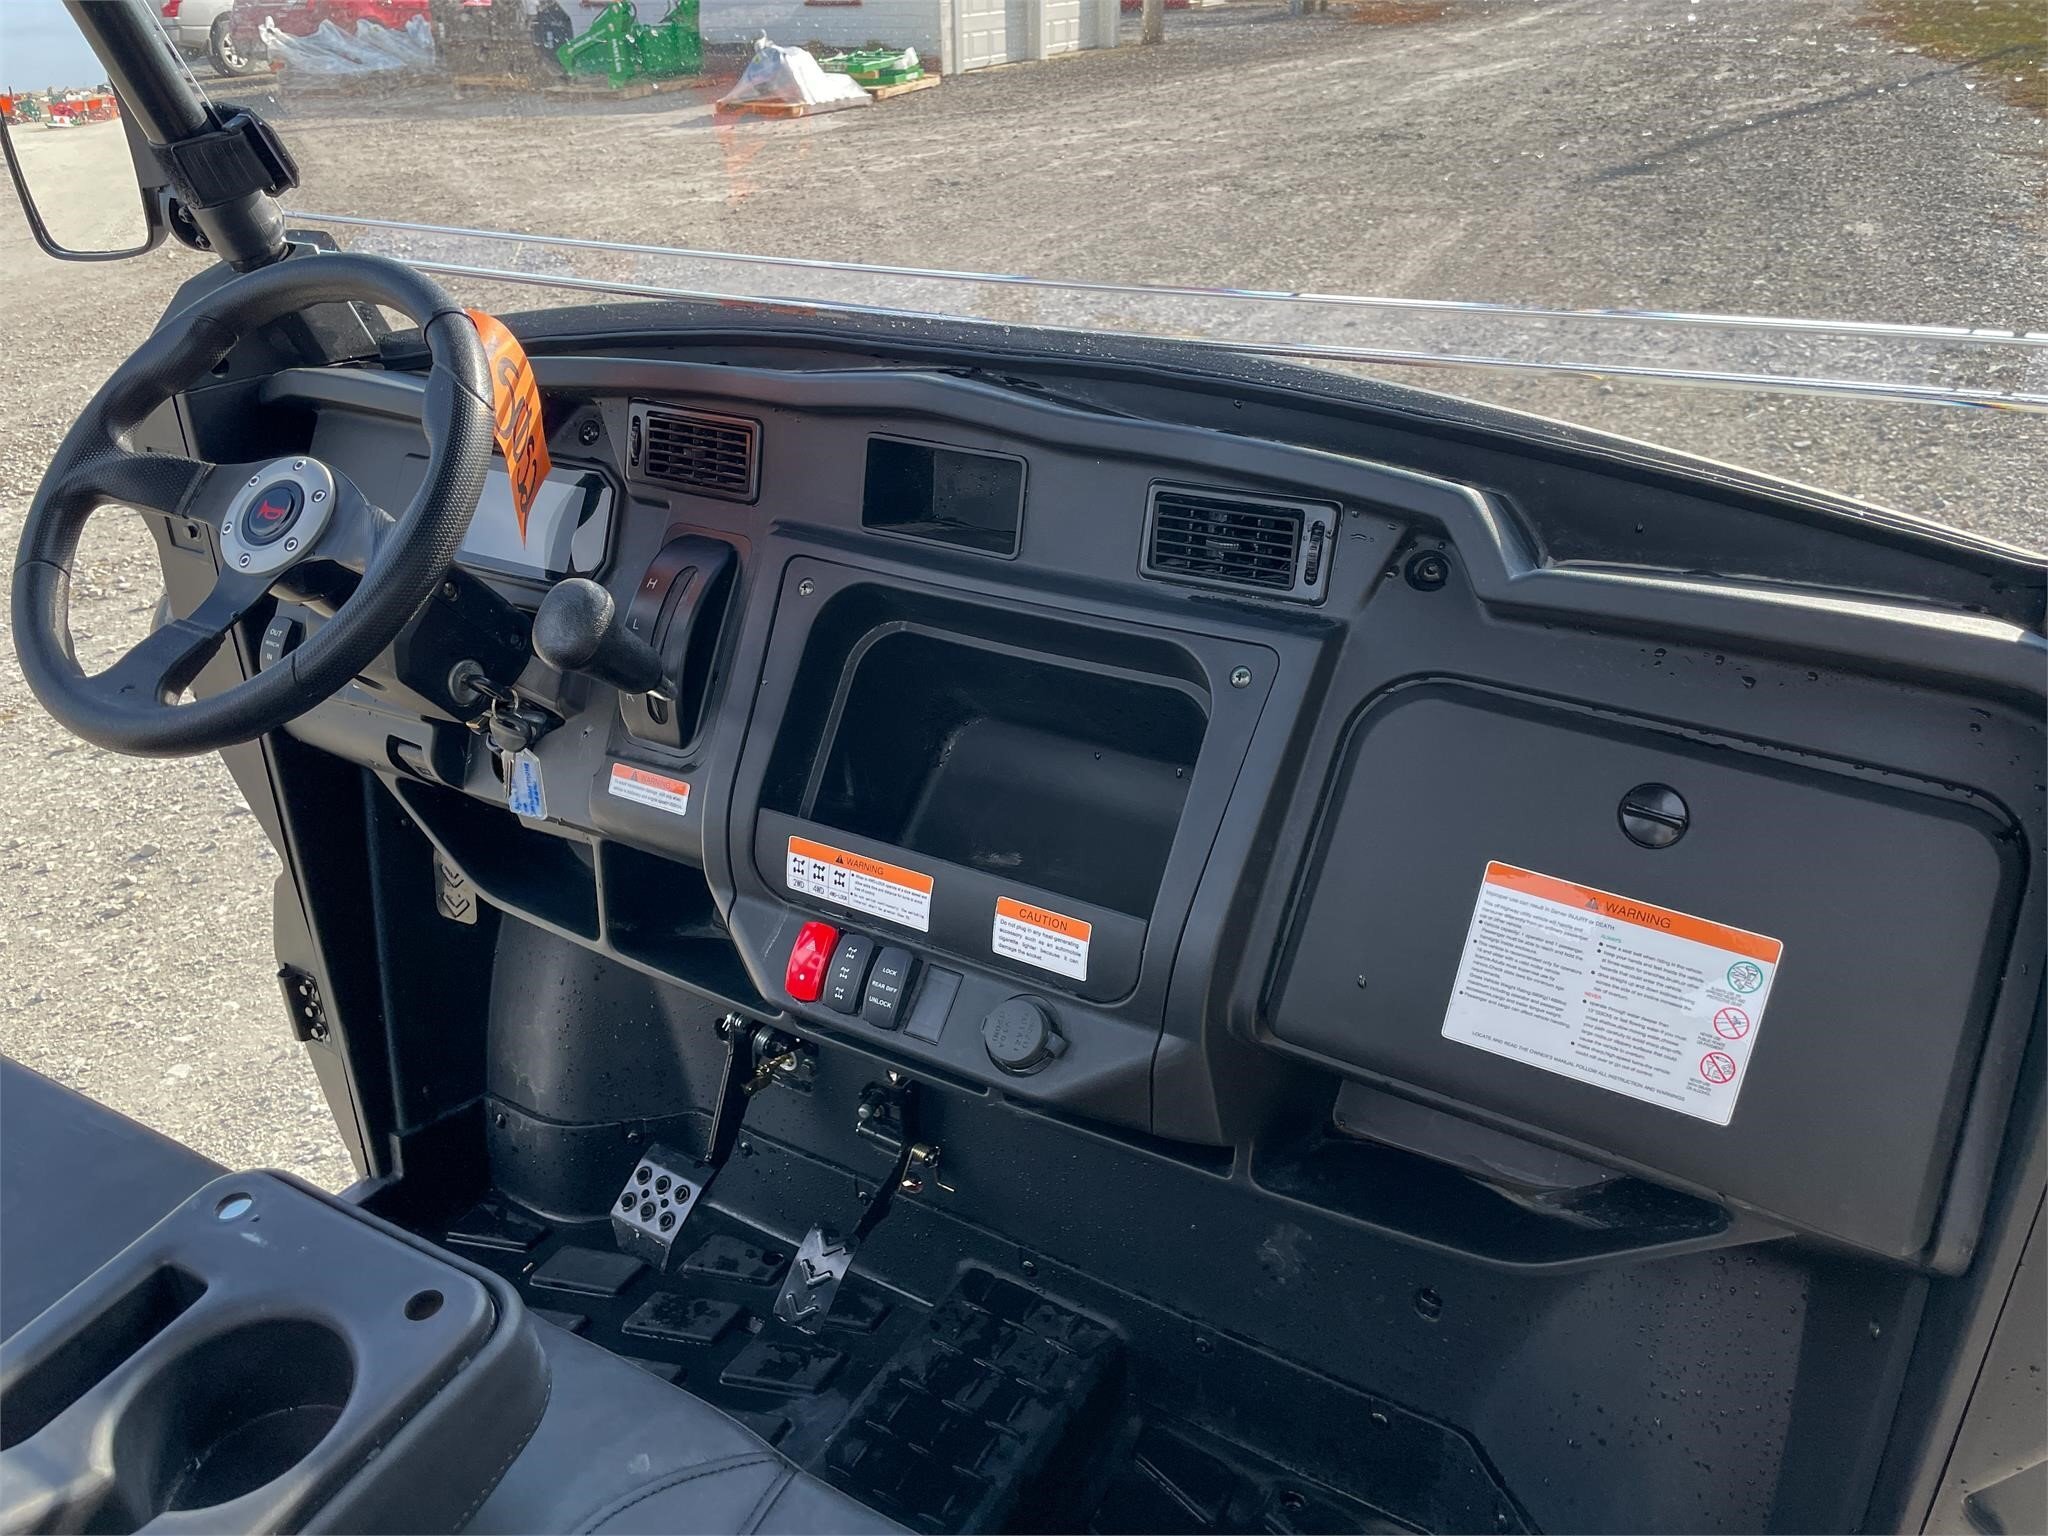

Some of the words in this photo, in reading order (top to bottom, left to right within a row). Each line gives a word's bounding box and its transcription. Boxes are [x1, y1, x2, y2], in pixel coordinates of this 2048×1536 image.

[646, 578, 658, 590] H
[632, 618, 639, 630] L
[269, 628, 283, 637] OUT
[266, 652, 273, 660] IN
[846, 857, 884, 876] WARNING
[793, 877, 804, 888] 2WD
[812, 883, 824, 895] 4WD
[1018, 907, 1068, 932] CAUTION
[1604, 901, 1672, 929] WARNING
[1016, 923, 1026, 932] plug
[1594, 920, 1615, 930] DEATH
[882, 967, 898, 976] LOCK
[871, 980, 886, 990] REAR
[886, 985, 898, 994] DIFF
[868, 995, 892, 1008] UNLOCK
[1471, 1030, 1491, 1041] LOCATE
[1492, 1036, 1503, 1044] AND
[1503, 1040, 1518, 1049] READ
[1518, 1044, 1529, 1052] THE
[1574, 1062, 1598, 1074] FOLLOW
[1597, 1069, 1607, 1077] ALL
[1643, 1084, 1655, 1092] AND
